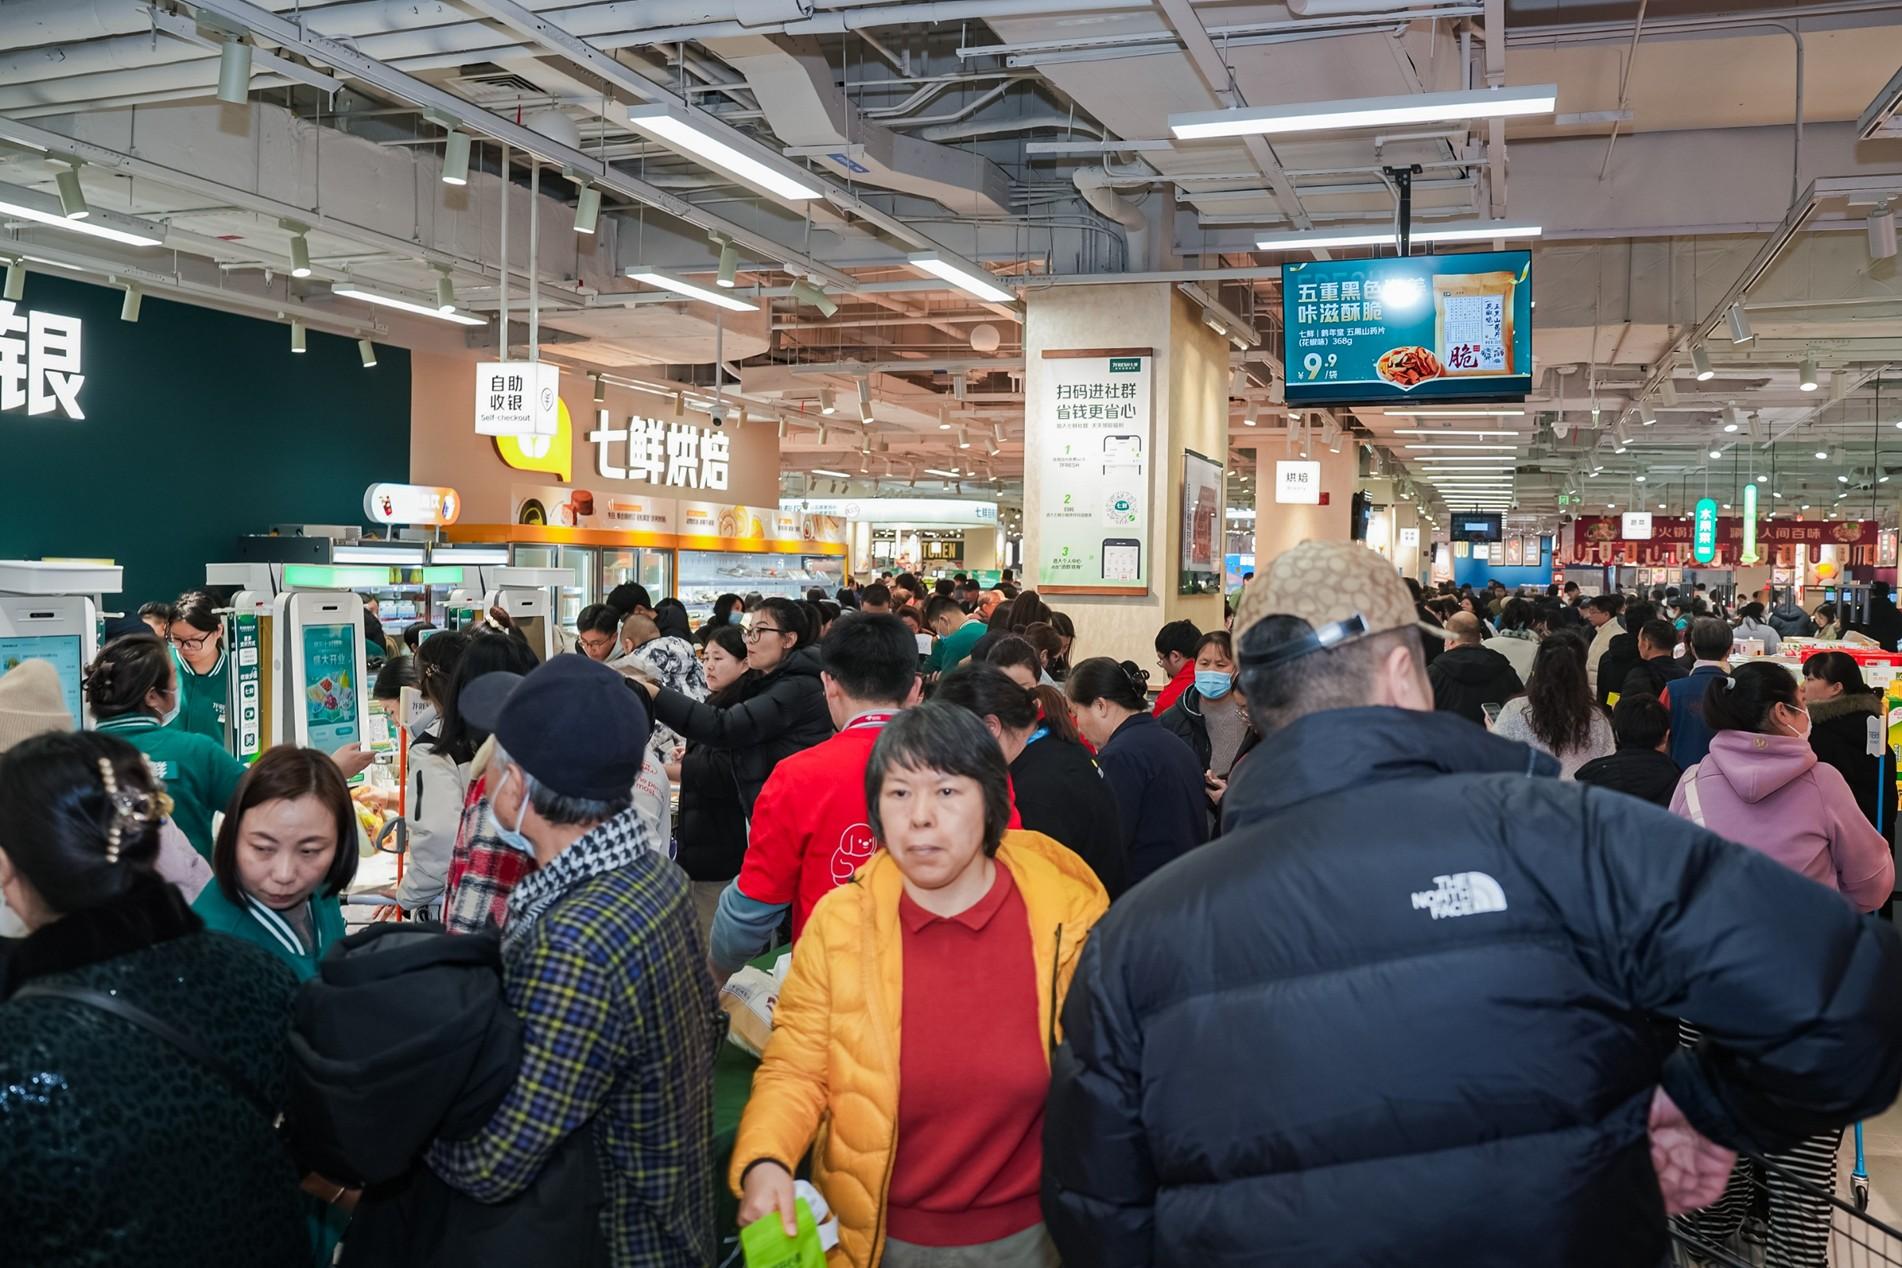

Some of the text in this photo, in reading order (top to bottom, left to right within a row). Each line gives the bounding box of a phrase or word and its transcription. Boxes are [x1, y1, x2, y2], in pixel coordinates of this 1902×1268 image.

[1298, 301, 1383, 324] 咔滋酥脆
[1332, 337, 1353, 346] 368g
[1448, 343, 1478, 369] 脆
[491, 375, 523, 392] 自助
[1056, 383, 1137, 400] 扫码进社群
[490, 394, 522, 411] 收银
[1056, 403, 1137, 420] 省钱更省心
[589, 408, 730, 490] 七鲜烘焙
[1064, 494, 1071, 504] 2
[1062, 546, 1069, 556] 3
[1433, 874, 1467, 891] THE
[1411, 886, 1472, 910] NORTH
[1429, 900, 1473, 920] FACE
